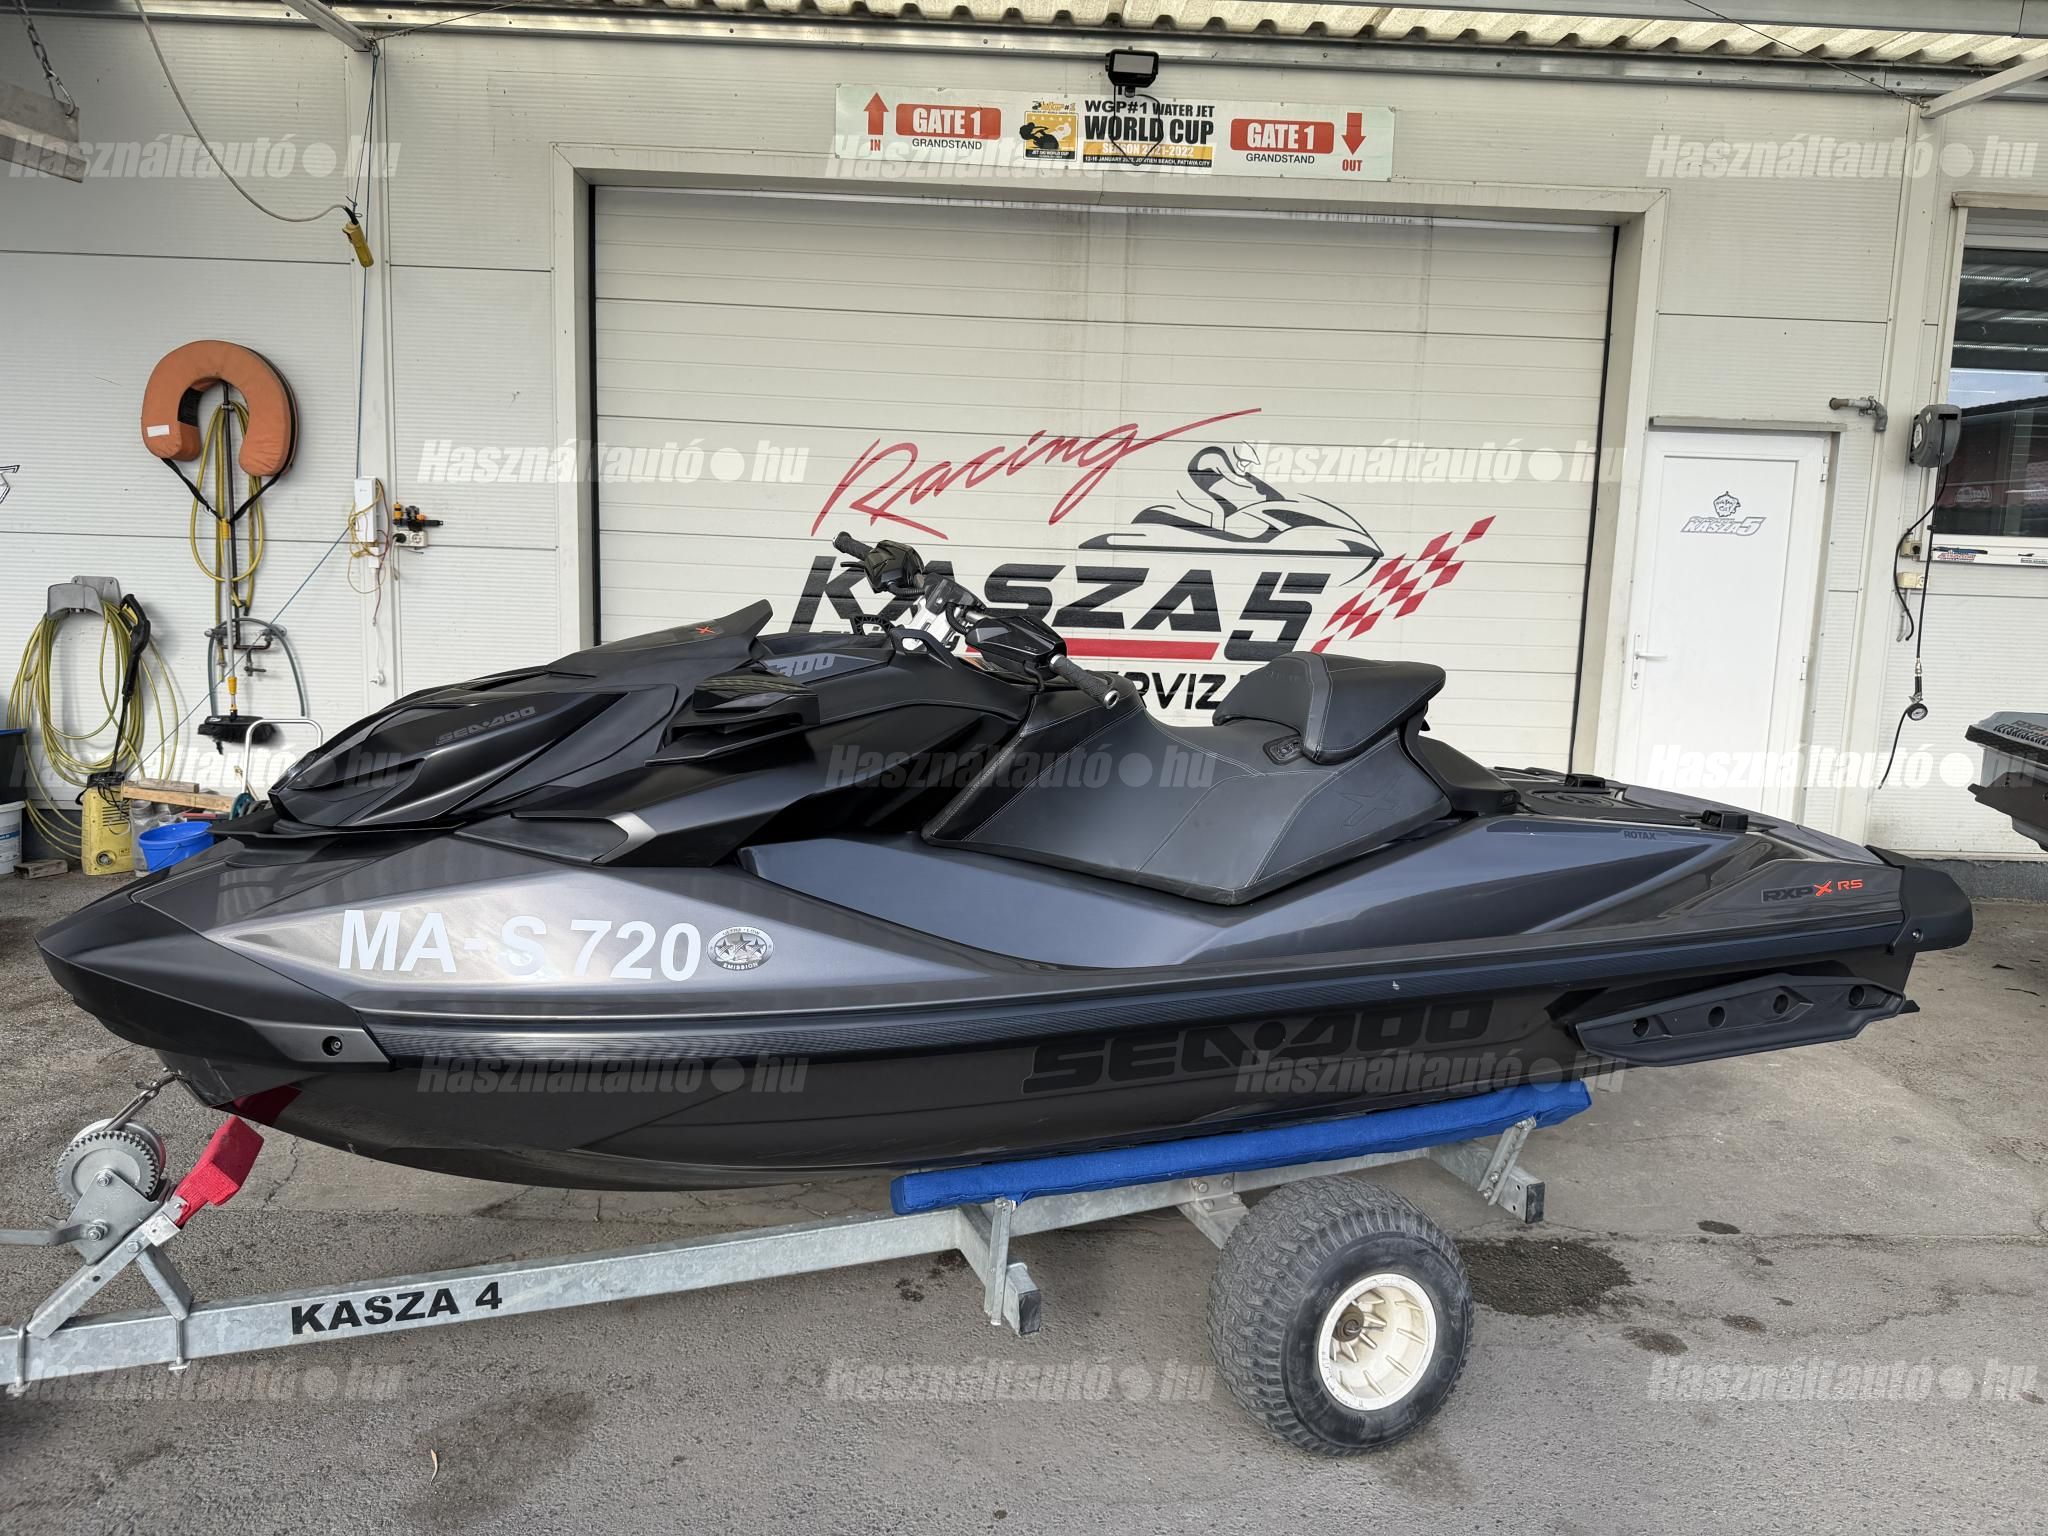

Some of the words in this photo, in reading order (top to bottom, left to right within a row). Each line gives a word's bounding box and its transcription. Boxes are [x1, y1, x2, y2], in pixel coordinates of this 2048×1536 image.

[1085, 100, 1147, 115] WGP#1
[1152, 103, 1196, 117] WATER
[1197, 105, 1215, 118] JET
[912, 107, 966, 135] GATE
[970, 110, 981, 136] 1
[1084, 115, 1164, 143] WORLD
[1169, 118, 1214, 145] CUP
[1246, 122, 1299, 149] GATE
[1303, 125, 1315, 150] 1
[869, 139, 881, 151] IN
[912, 138, 982, 150] GRANDSTAND
[1246, 153, 1315, 165] GRANDSTAND
[1342, 159, 1363, 172] OUT
[811, 408, 1261, 540] Racing
[1623, 830, 1657, 840] ROTAX
[1837, 879, 1863, 891] RS
[569, 919, 701, 982] 720
[722, 962, 759, 971] EMISSION
[291, 1287, 461, 1335] KASZA
[475, 1281, 503, 1310] 4
